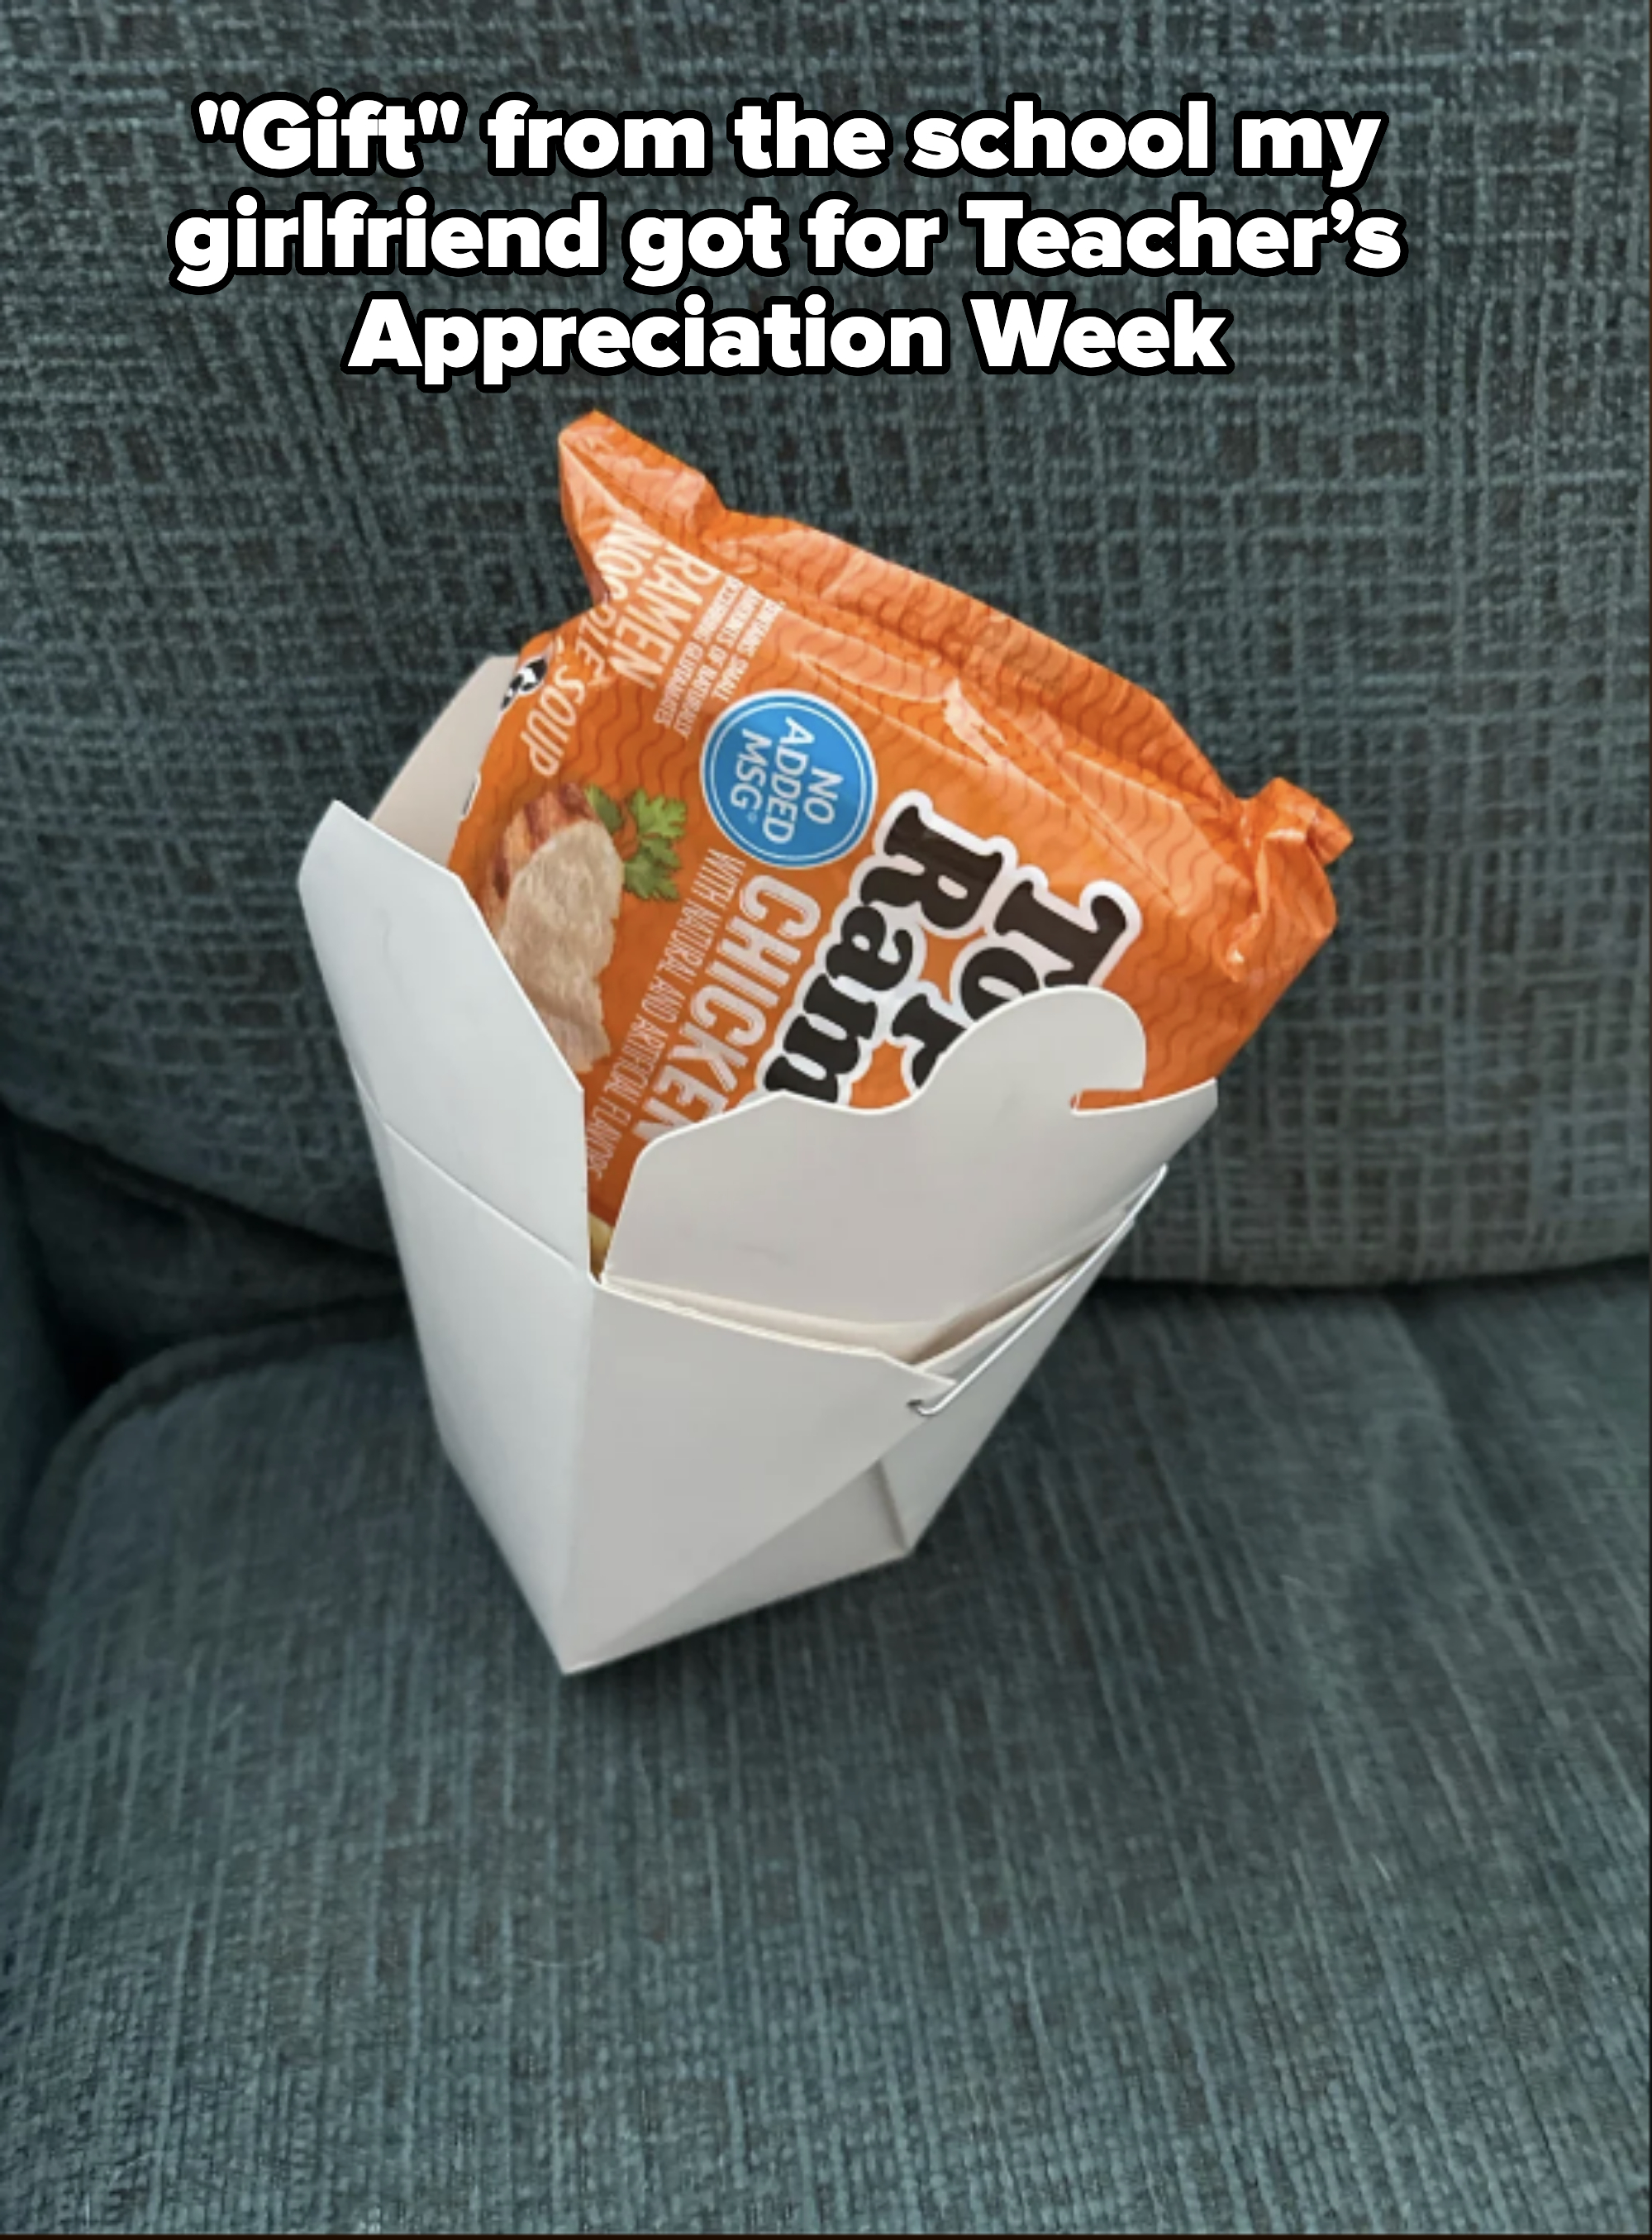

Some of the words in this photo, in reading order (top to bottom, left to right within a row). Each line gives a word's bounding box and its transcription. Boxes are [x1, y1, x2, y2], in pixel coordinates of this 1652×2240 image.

[609, 541, 722, 691] RAMEN
[519, 664, 586, 778] SOUP
[761, 715, 816, 846] ADDED
[802, 765, 845, 825] NO
[690, 848, 747, 910] WITH
[656, 898, 721, 984] NATURAL
[631, 873, 822, 1141] CHICKEN
[640, 974, 686, 1025] AND
